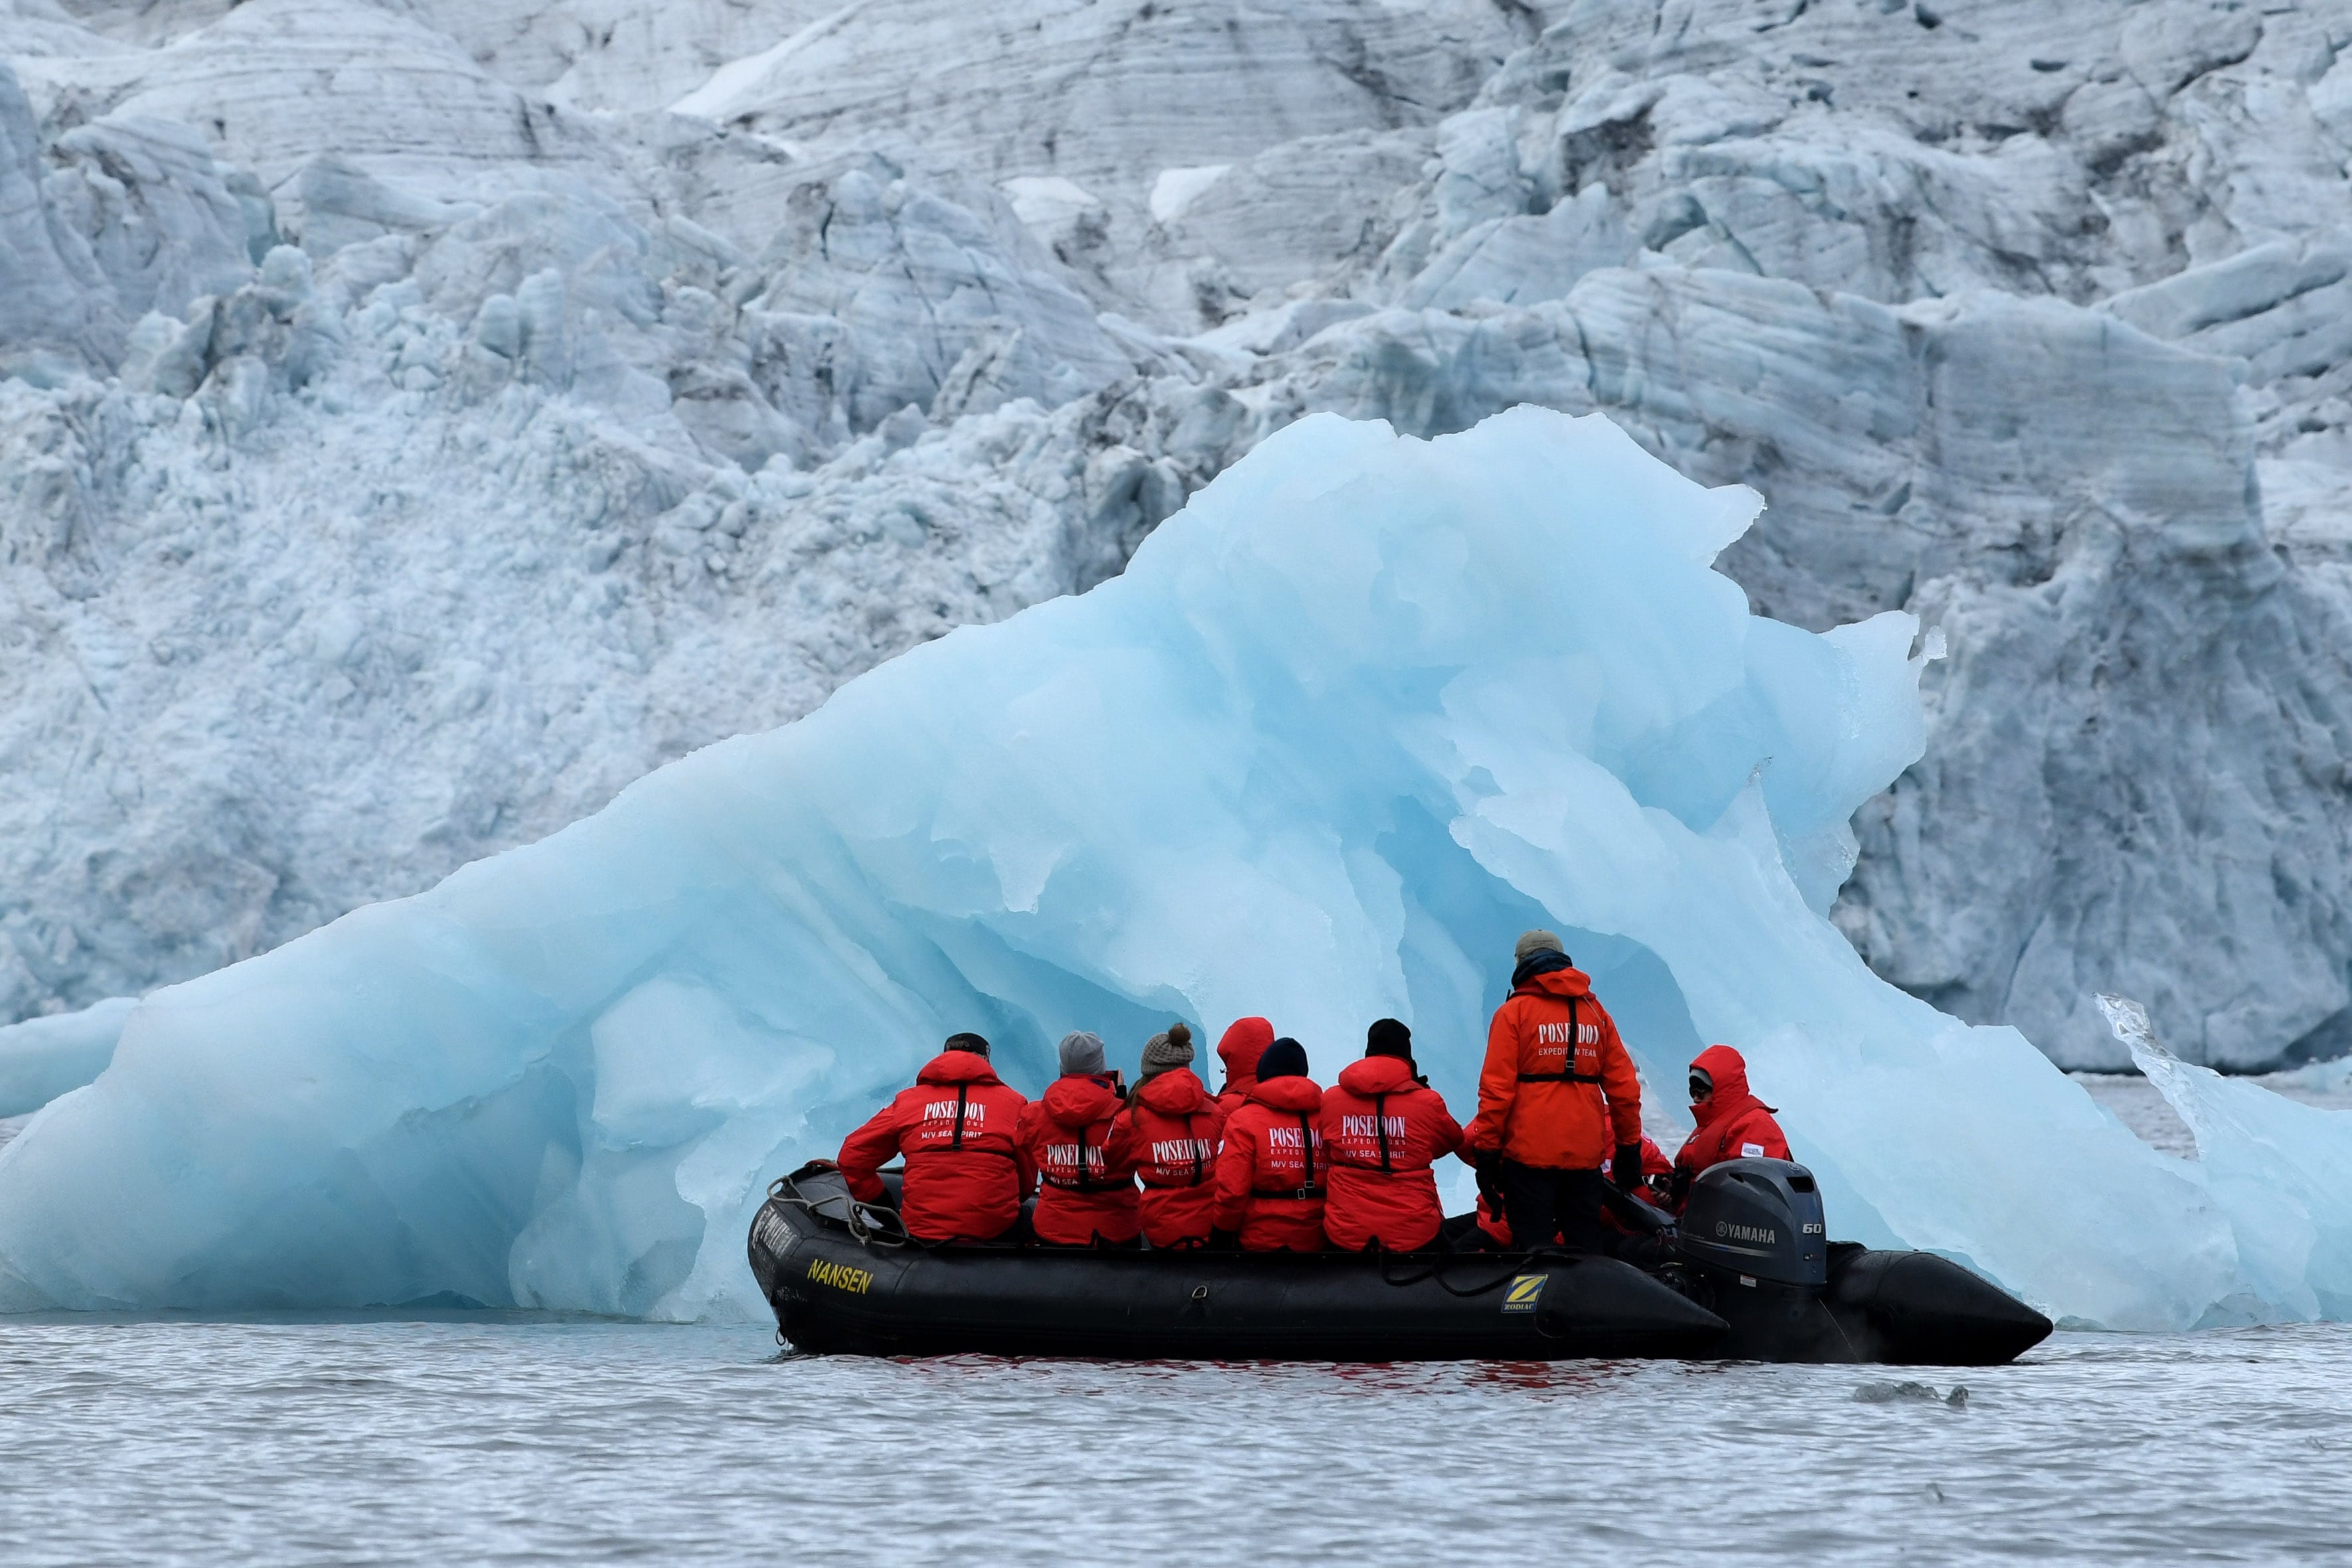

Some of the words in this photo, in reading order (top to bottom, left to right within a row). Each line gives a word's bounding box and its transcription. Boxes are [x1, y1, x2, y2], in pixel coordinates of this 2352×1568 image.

[1538, 1022, 1599, 1044] POSEDON
[1156, 1167, 1170, 1176] M/V
[1728, 1223, 1775, 1244] YAMAHA
[1802, 1223, 1822, 1234] 60
[807, 1258, 874, 1295] NANSEN
